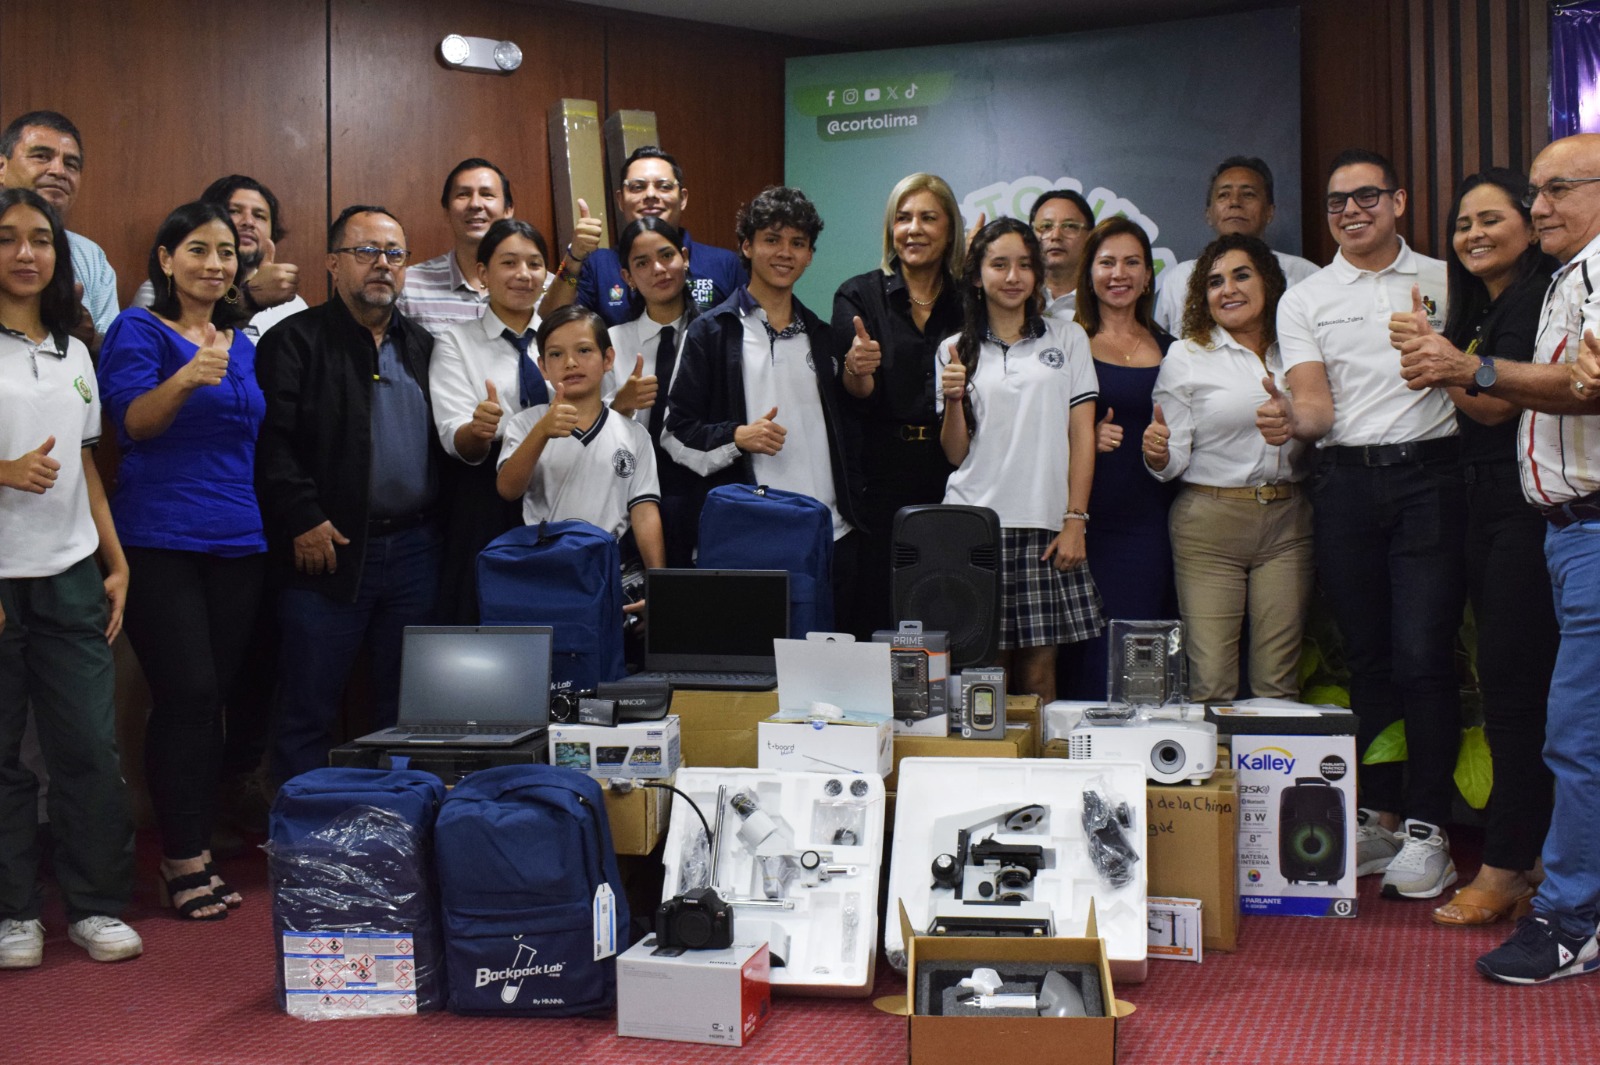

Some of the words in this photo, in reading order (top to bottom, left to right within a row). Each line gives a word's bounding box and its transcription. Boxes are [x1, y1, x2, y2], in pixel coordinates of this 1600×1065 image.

[827, 113, 918, 135] @cortolima
[893, 636, 924, 645] PRIME
[961, 683, 972, 738] GARMIN
[1237, 753, 1296, 775] Kalley
[1177, 795, 1192, 812] la
[1193, 796, 1232, 814] China
[1244, 812, 1252, 822] 8
[1254, 813, 1267, 822] W
[1245, 897, 1282, 905] PARLANTE
[475, 967, 542, 988] Backpack
[543, 962, 564, 974] Lab
